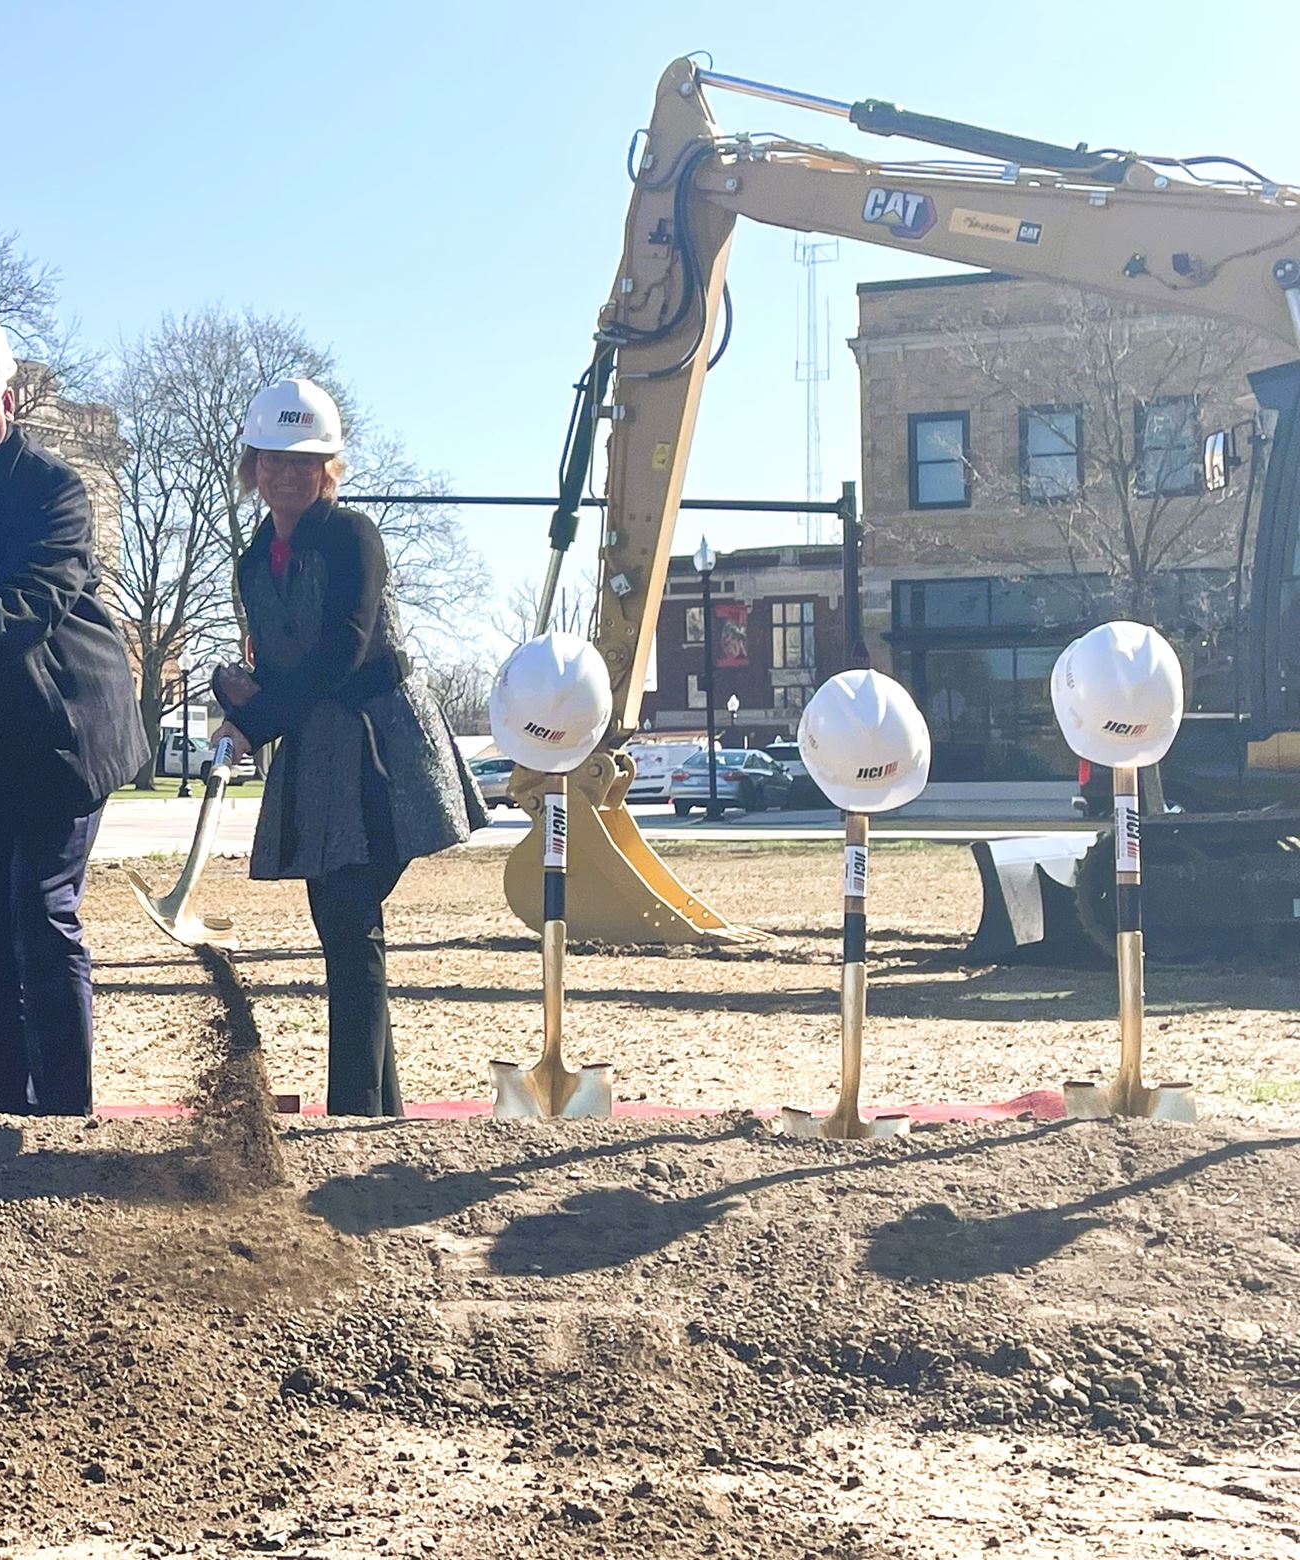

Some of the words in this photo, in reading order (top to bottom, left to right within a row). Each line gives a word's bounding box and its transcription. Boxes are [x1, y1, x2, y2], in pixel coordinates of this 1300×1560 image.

[863, 187, 924, 228] CAT
[1019, 225, 1040, 240] CAT
[524, 722, 551, 739] JICI
[1102, 720, 1132, 735] JICI
[856, 765, 883, 779] JICI
[552, 804, 566, 837] JICI
[1125, 807, 1141, 840] JICI
[854, 850, 866, 877] JICI
